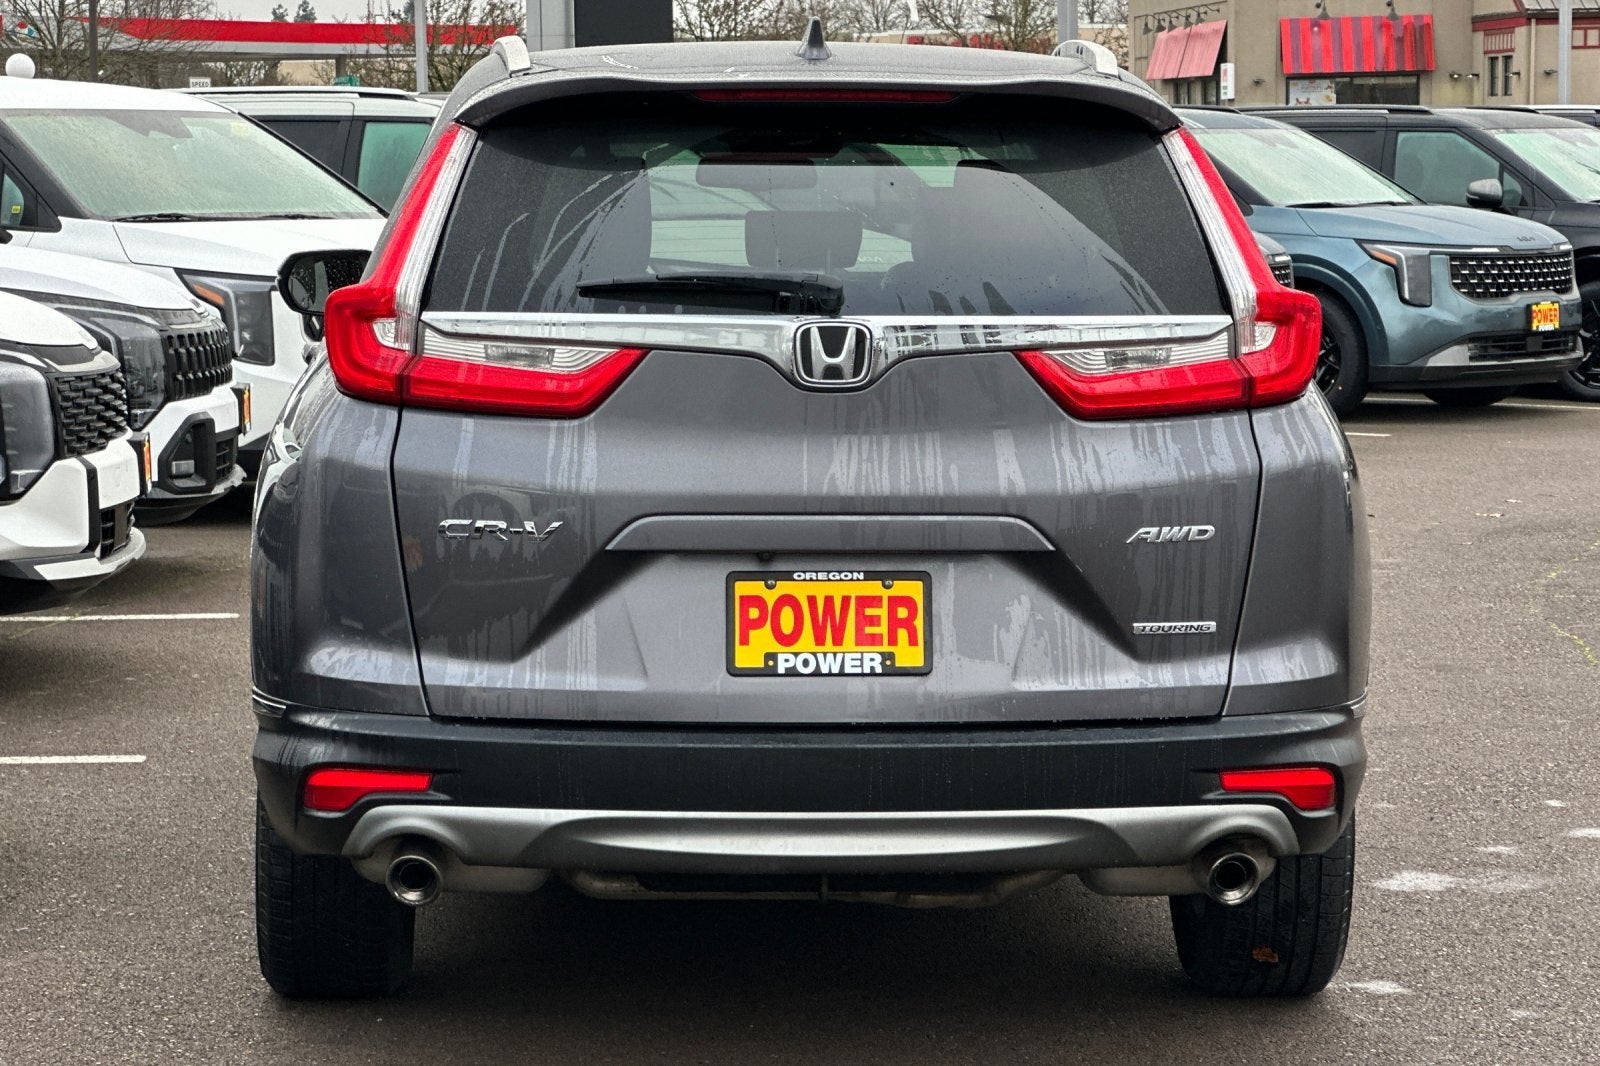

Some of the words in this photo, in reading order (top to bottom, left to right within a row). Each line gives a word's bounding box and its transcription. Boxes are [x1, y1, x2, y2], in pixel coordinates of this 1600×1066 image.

[1531, 308, 1558, 324] POWER
[438, 519, 564, 542] CR-V
[1126, 525, 1215, 543] AWD
[793, 572, 864, 580] OREGON
[739, 594, 919, 647] POWER
[1138, 624, 1211, 633] TOURING
[777, 653, 882, 674] POWER
